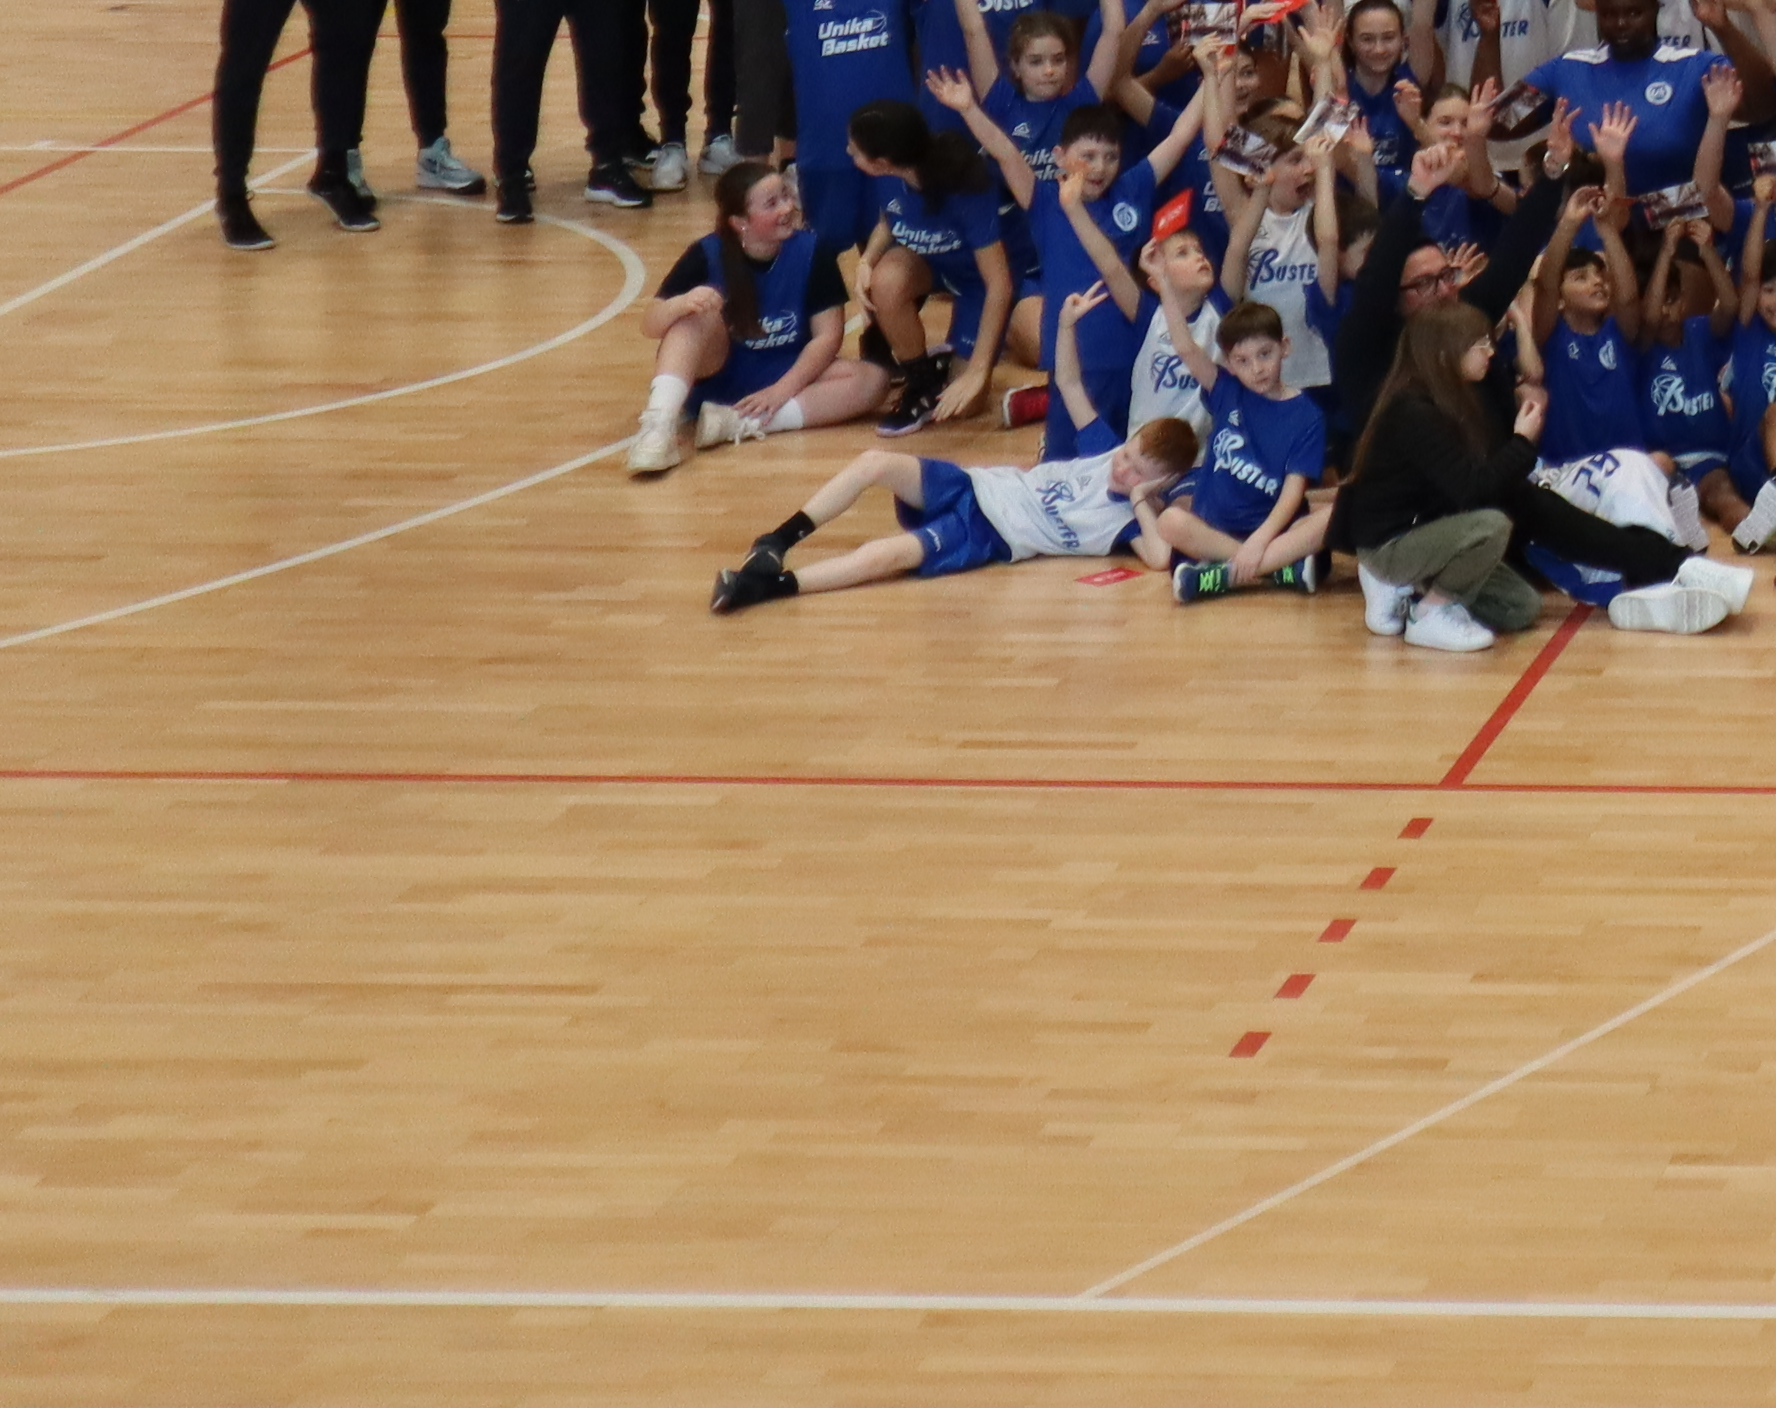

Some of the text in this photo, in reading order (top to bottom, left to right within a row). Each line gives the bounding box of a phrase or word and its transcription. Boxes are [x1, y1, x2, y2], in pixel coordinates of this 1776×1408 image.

[818, 17, 874, 41] Unika
[821, 31, 891, 57] Basket
[1254, 250, 1317, 290] BUSTE
[1214, 429, 1281, 497] BUSTER
